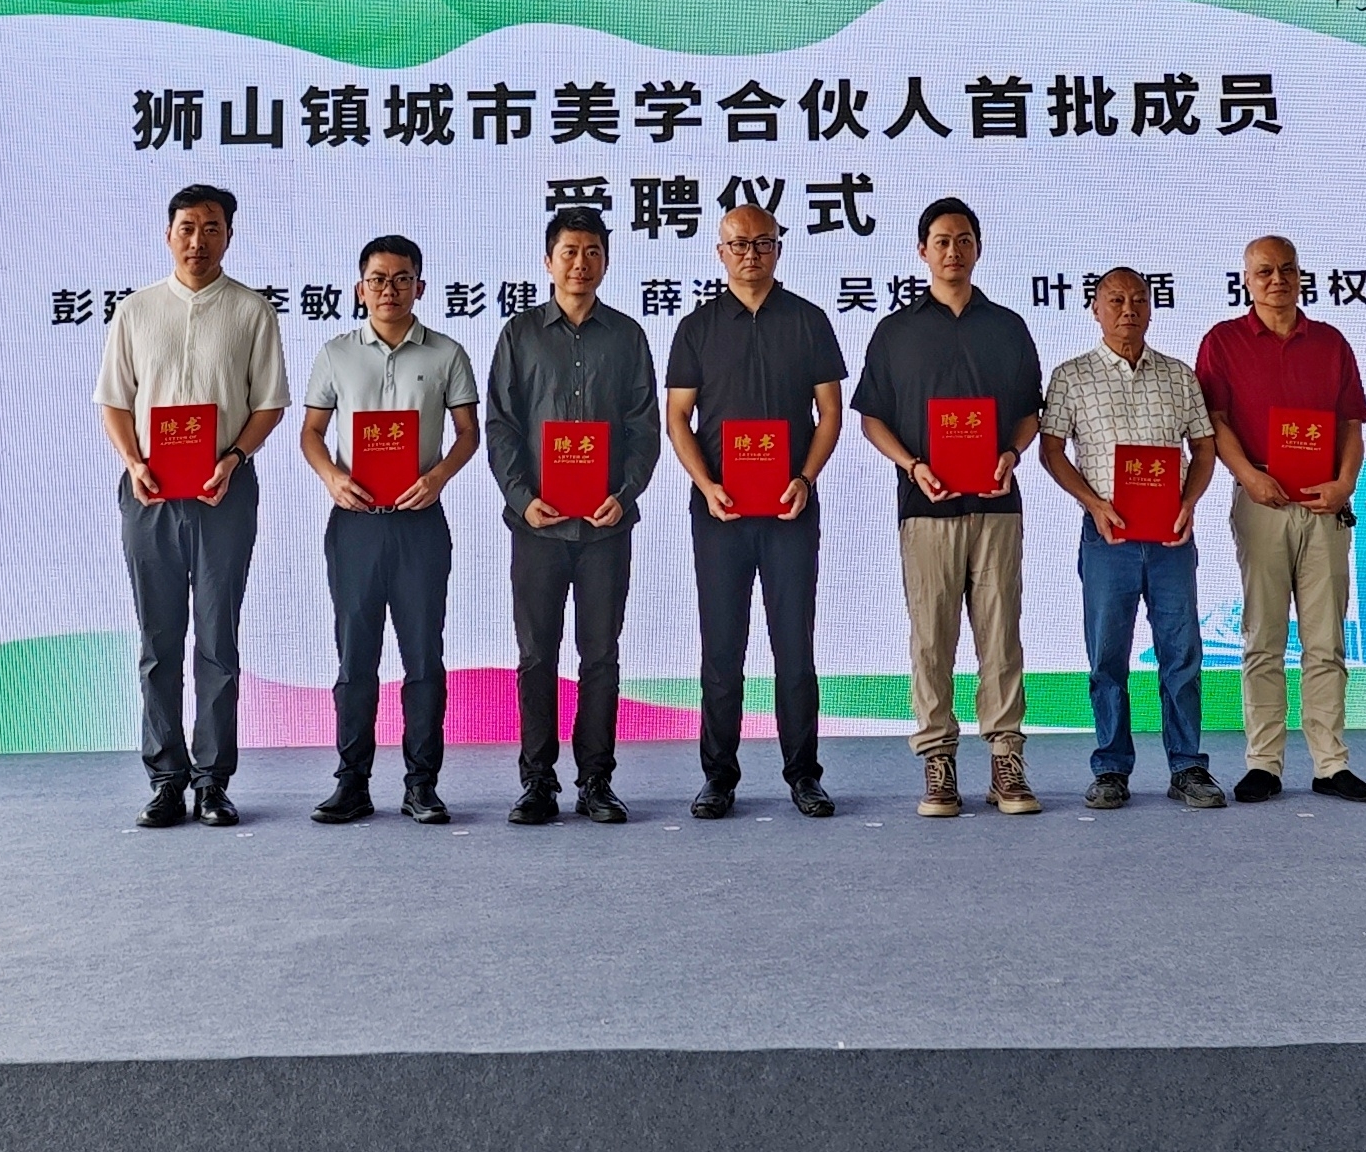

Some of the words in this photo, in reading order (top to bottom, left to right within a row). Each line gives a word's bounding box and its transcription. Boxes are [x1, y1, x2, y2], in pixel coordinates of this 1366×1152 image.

[132, 73, 1284, 150] 狮山镇城市美学合伙人首批成员
[546, 172, 876, 239] 受聘仪式
[445, 281, 555, 318] 彭健
[160, 416, 201, 435] 聘书
[940, 411, 982, 429] 聘书
[363, 422, 405, 441] 聘书
[1281, 422, 1323, 441] 聘书
[553, 435, 595, 454] 聘书
[734, 433, 775, 452] 聘书
[1125, 458, 1167, 477] 聘书
